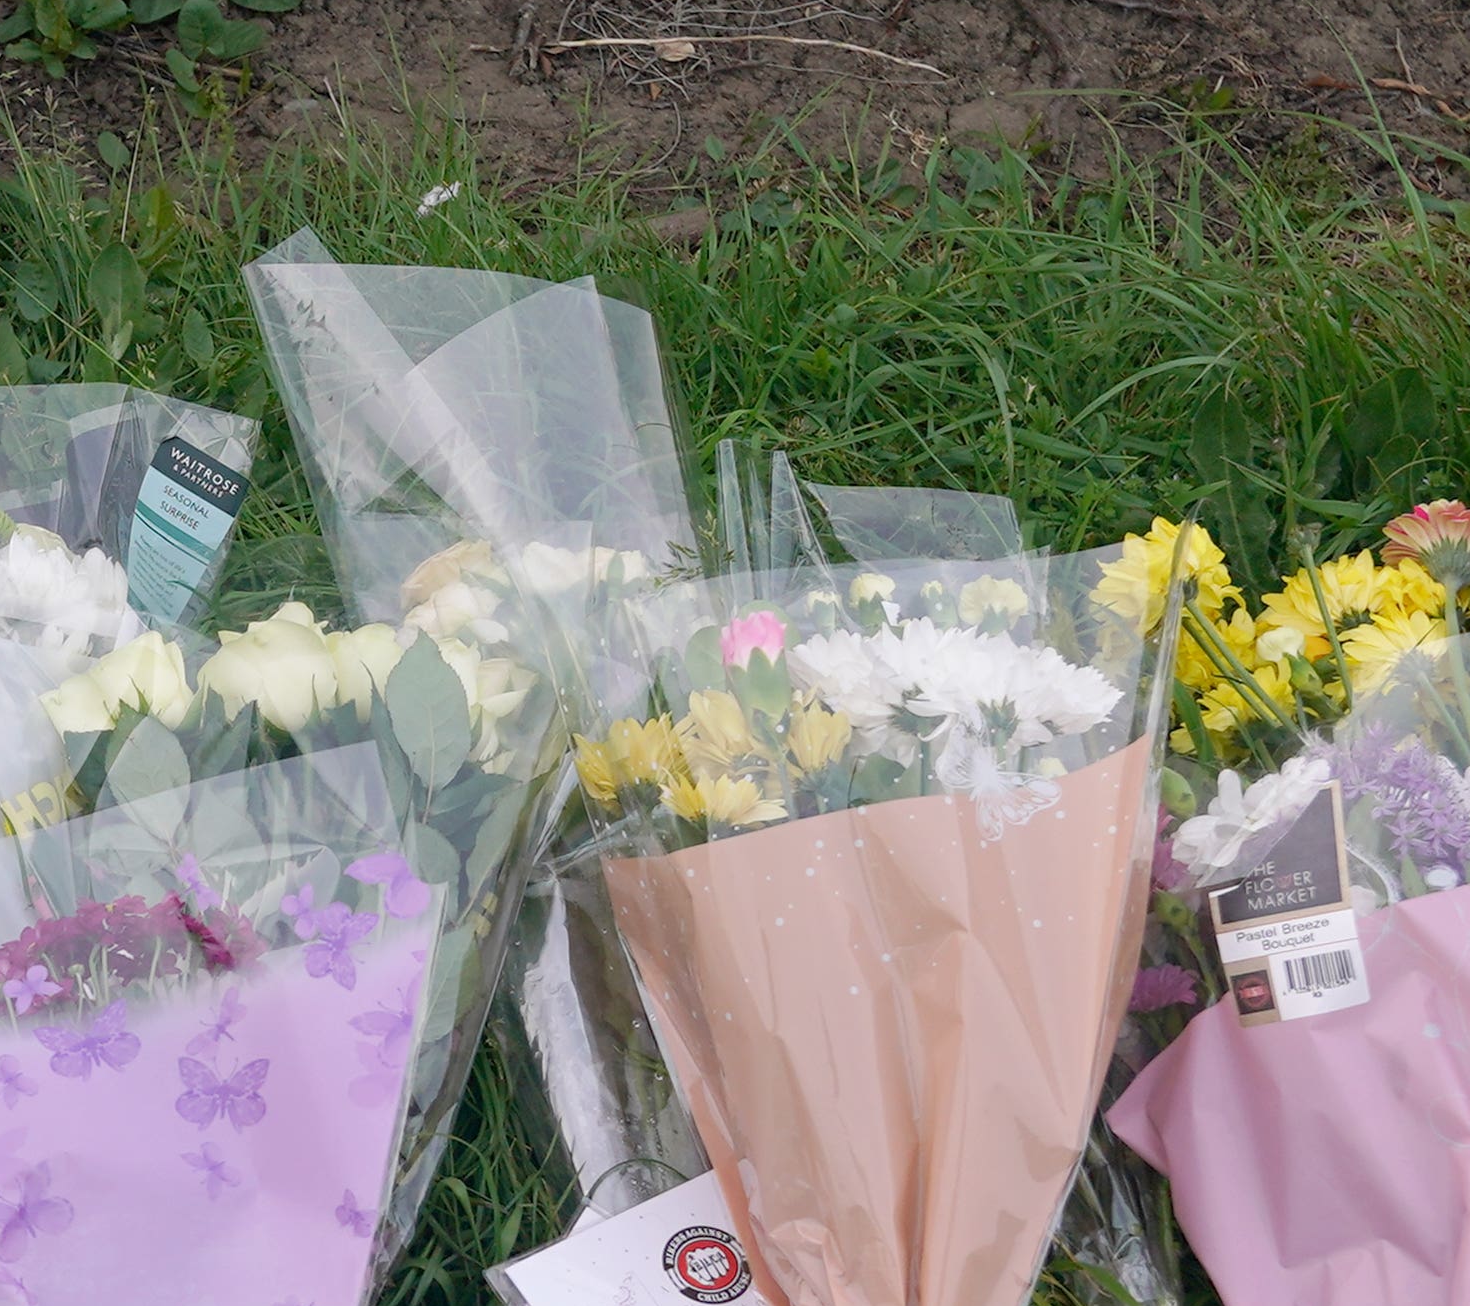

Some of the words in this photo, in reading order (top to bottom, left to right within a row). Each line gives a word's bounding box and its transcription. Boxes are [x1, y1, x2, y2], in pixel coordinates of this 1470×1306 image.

[170, 446, 240, 496] WAITROSE
[180, 468, 225, 498] PARTNERS
[159, 500, 199, 531] SURPRISE
[163, 484, 211, 519] SEASONAL
[1252, 860, 1277, 876] HE
[1247, 886, 1318, 911] MARKET
[1236, 926, 1278, 943] Pastel
[1281, 917, 1330, 936] Breeze
[1261, 932, 1316, 952] Bouquet
[665, 1231, 687, 1265] BIKERS
[684, 1227, 729, 1241] AGAINST
[697, 1290, 729, 1303] CHILD
[729, 1273, 751, 1298] ABUSE
